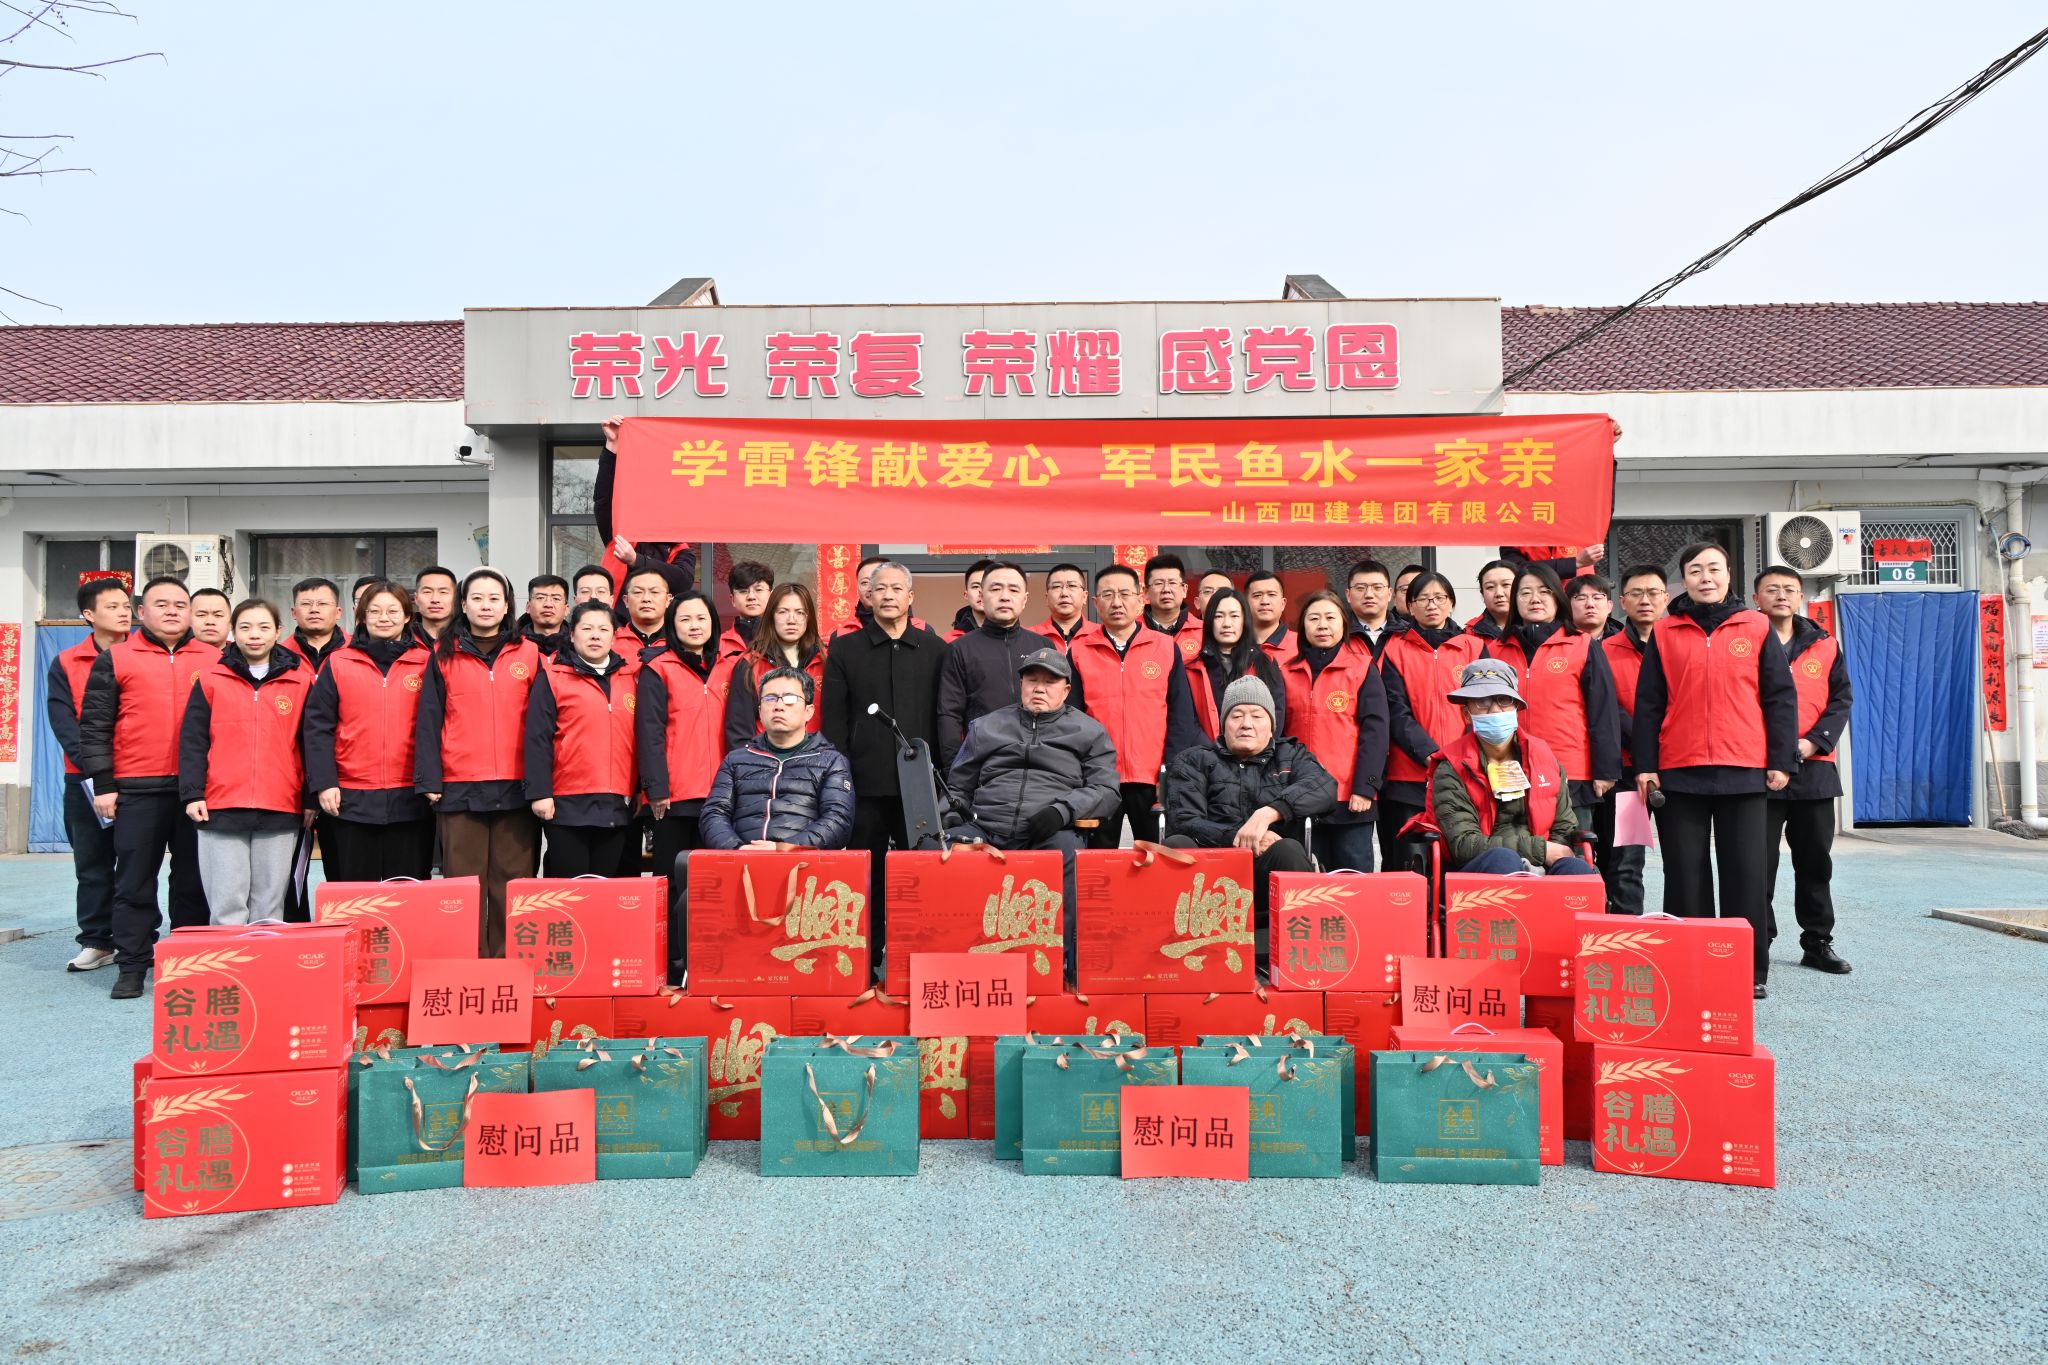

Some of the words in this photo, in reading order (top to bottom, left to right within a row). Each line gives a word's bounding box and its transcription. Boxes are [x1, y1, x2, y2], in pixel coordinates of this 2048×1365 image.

[569, 330, 728, 399] 荣光
[766, 330, 925, 399] 荣复
[962, 327, 1122, 396] 荣耀
[1160, 323, 1401, 394] 感党恩
[671, 438, 1060, 489] 学雷锋献爱心
[1100, 437, 1557, 489] 军民鱼水一家亲
[195, 555, 211, 563] 新飞
[1892, 568, 1916, 581] 06
[514, 920, 573, 947] 谷膳
[1286, 915, 1346, 942] 谷膳
[1455, 917, 1518, 945] 谷膳
[358, 958, 391, 985] 遇
[1287, 945, 1348, 973] 礼遇
[922, 977, 1014, 1008] 慰问品
[1583, 962, 1655, 994] 谷膳
[163, 984, 241, 1018] 谷膳
[422, 983, 520, 1018] 慰问品
[1412, 985, 1506, 1017] 慰问品
[1582, 994, 1657, 1027] 礼遇
[161, 1020, 242, 1055] 礼遇
[1602, 1090, 1676, 1124] 谷膳
[155, 1123, 234, 1159] 谷膳
[478, 1121, 580, 1157] 慰问品
[1133, 1115, 1234, 1149] 慰问品
[1601, 1123, 1678, 1157] 礼遇
[153, 1159, 235, 1194] 礼遇
